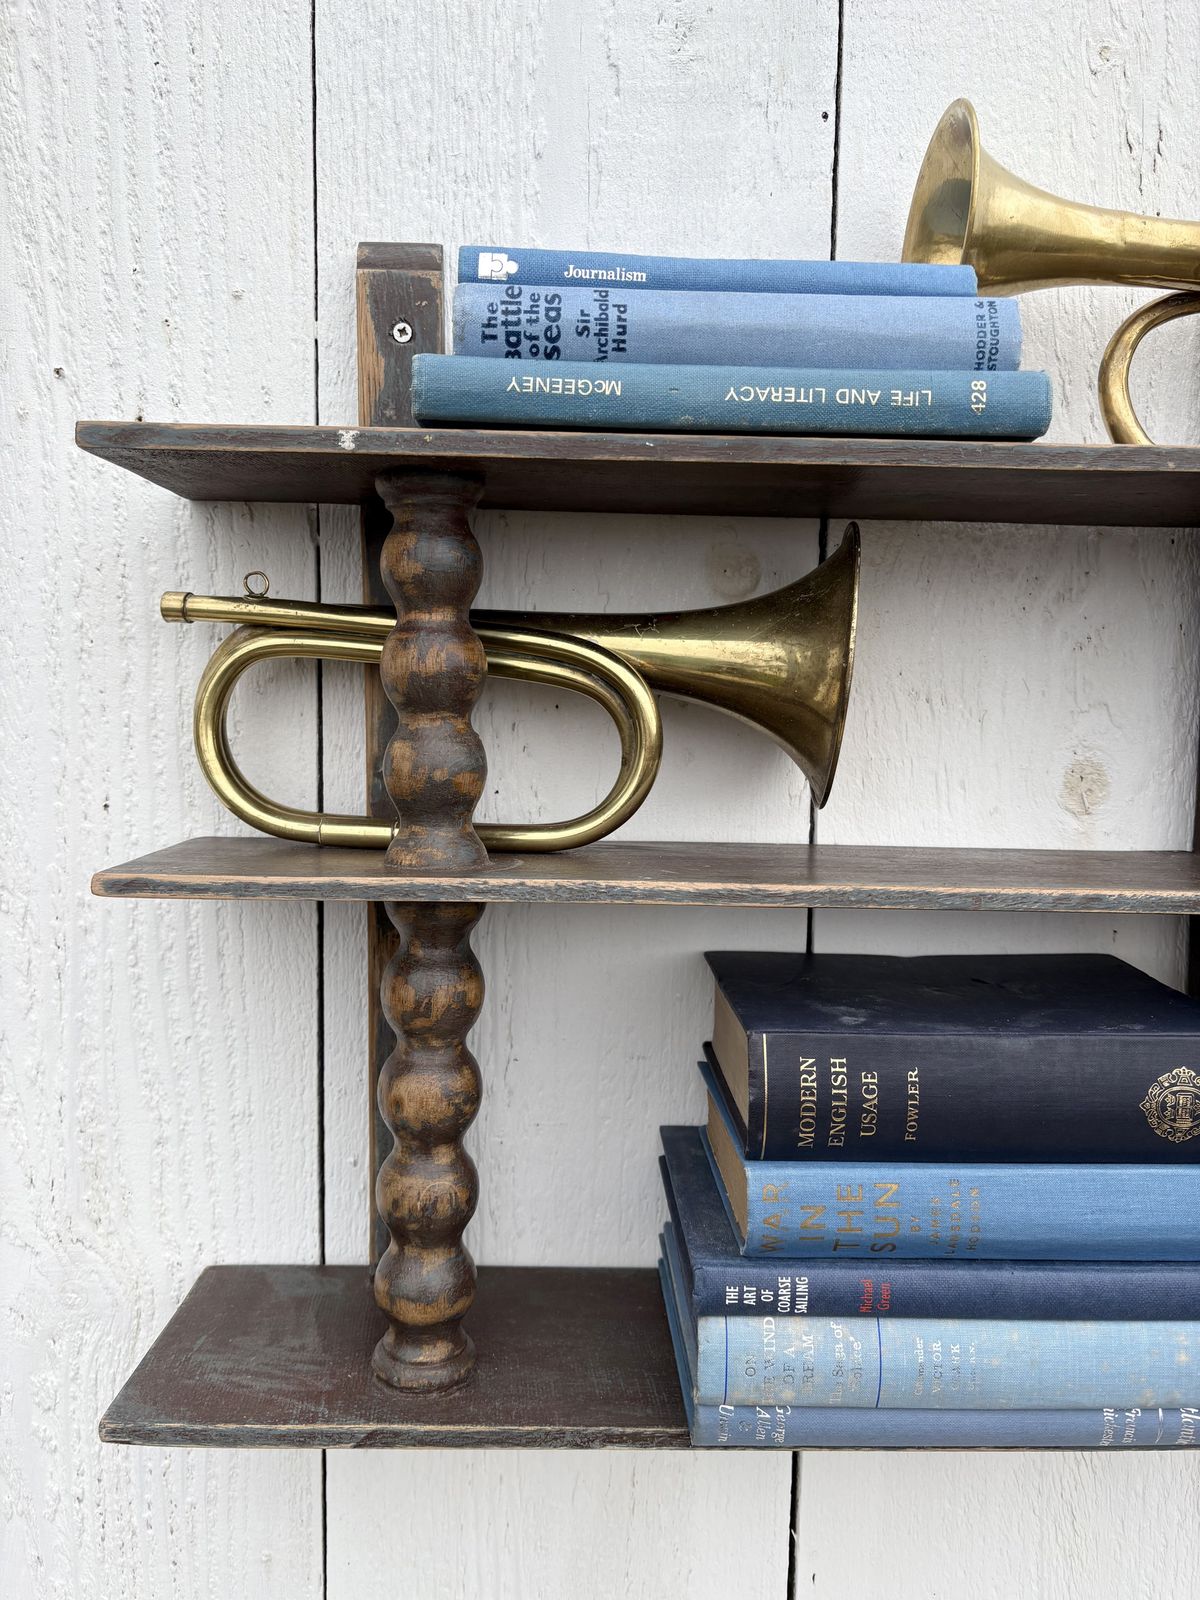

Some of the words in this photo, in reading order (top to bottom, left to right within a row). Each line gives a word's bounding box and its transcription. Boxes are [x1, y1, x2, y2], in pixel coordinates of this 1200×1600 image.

[564, 265, 647, 282] Journalism
[523, 292, 540, 326] the
[974, 300, 985, 309] &
[481, 302, 498, 344] The
[544, 293, 562, 360] seas
[576, 309, 591, 338] Sir
[612, 303, 628, 353] Hurd
[987, 300, 1000, 371] STOUGHTON
[523, 330, 540, 358] of
[974, 314, 987, 371] HODDER
[507, 377, 622, 396] McGEENEY
[725, 385, 826, 402] LITERACY
[836, 388, 881, 405] AND
[891, 390, 932, 406] LIFE
[971, 380, 987, 416] 428
[797, 1056, 817, 1148] MODERN
[828, 1057, 848, 1147] ENGLISH
[859, 1071, 878, 1137] USAGE
[905, 1067, 920, 1141] FOWLER
[759, 1181, 789, 1255] WAR
[800, 1205, 826, 1241] IN
[832, 1184, 864, 1252] THE
[870, 1182, 900, 1253] SUN
[910, 1215, 921, 1233] BY
[929, 1196, 941, 1246] JAMES
[945, 1178, 961, 1256] LANSDALE
[726, 1285, 739, 1305] THE
[743, 1285, 757, 1306] ART
[761, 1289, 774, 1302] OF
[778, 1276, 791, 1313] COARSE
[794, 1276, 809, 1314] SAILING
[859, 1279, 874, 1313] Michael
[877, 1282, 891, 1311] Green
[830, 1321, 843, 1338] of
[783, 1345, 796, 1359] A
[755, 1406, 772, 1441] Allen
